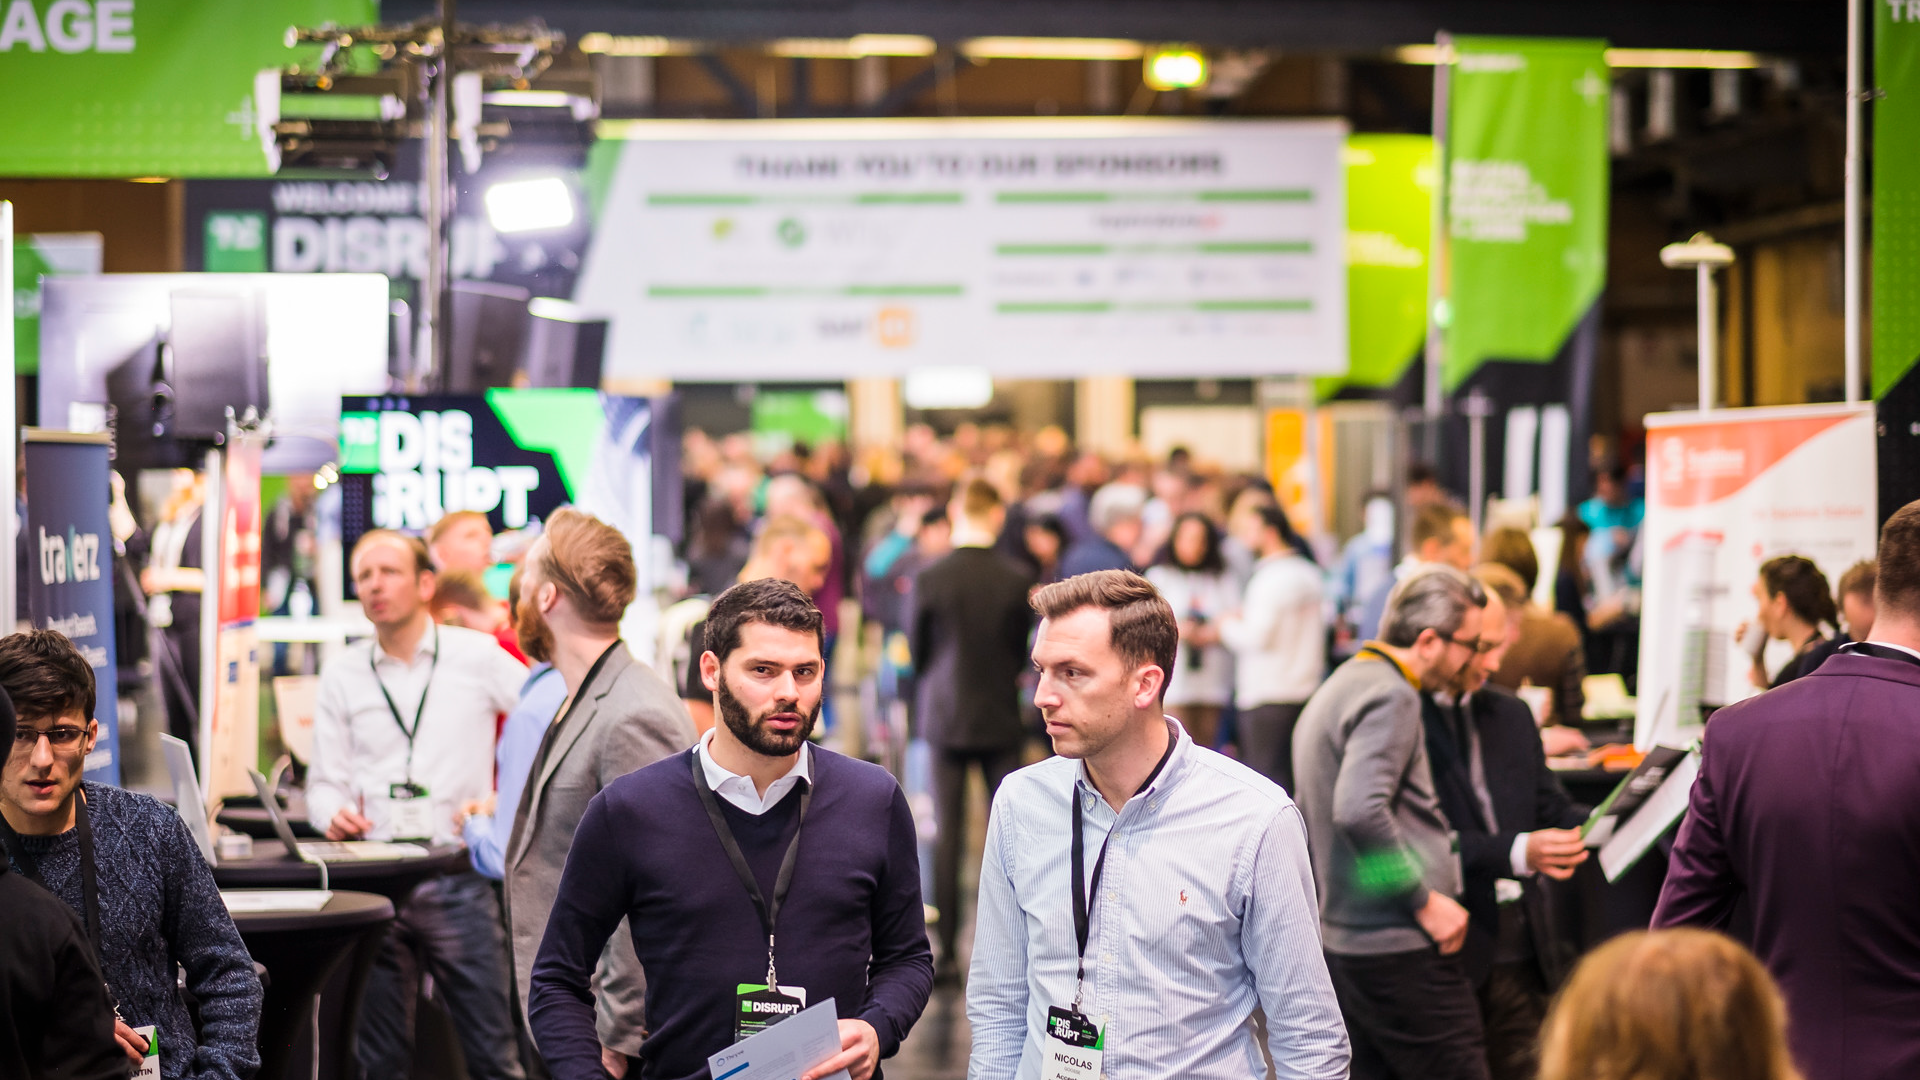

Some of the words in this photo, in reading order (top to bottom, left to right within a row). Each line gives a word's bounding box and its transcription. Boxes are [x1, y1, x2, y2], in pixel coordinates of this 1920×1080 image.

[381, 409, 474, 473] DIS
[752, 1001, 800, 1014] DISRUPT
[1056, 1017, 1071, 1030] DIS
[1054, 1052, 1093, 1071] NICOLAS
